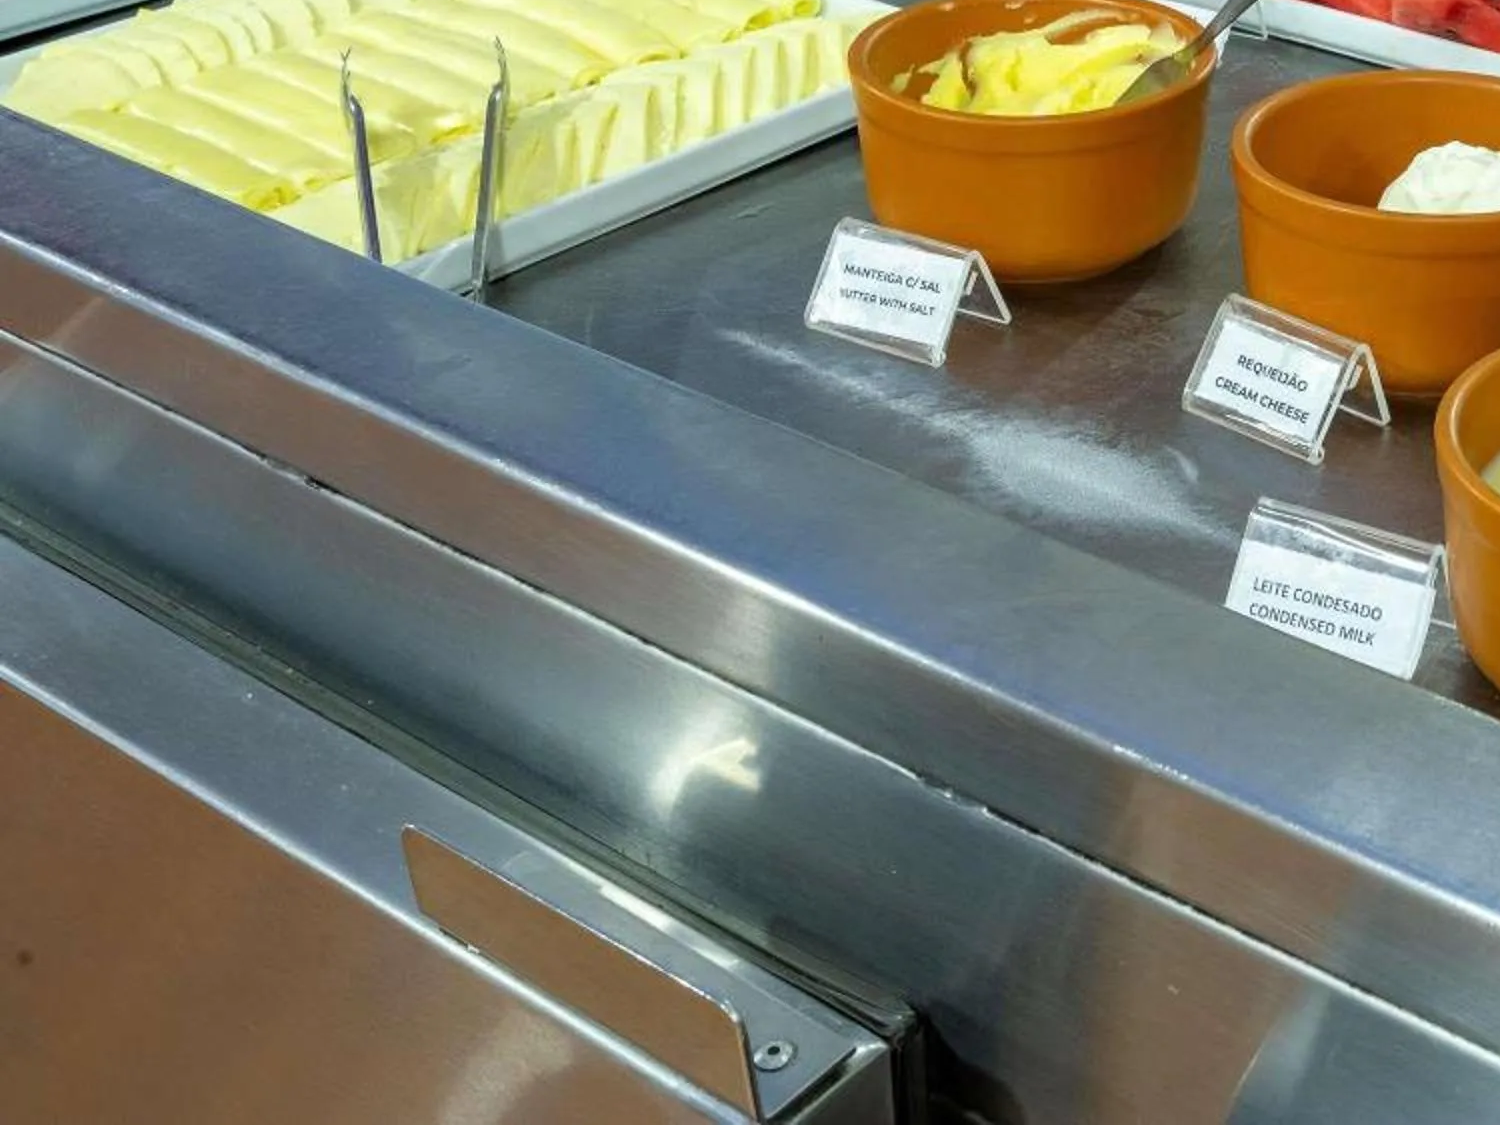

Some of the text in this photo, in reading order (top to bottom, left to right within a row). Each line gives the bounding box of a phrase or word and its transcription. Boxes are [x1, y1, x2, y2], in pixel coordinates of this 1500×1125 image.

[843, 263, 941, 294] MANTEIGA C/ SAL
[879, 296, 907, 312] WITH
[909, 302, 935, 316] SALT
[1215, 376, 1311, 424] CREAM CHEESE
[1253, 577, 1383, 622] LEITE CONDESADO
[1249, 602, 1376, 646] CONDENSED MILK
